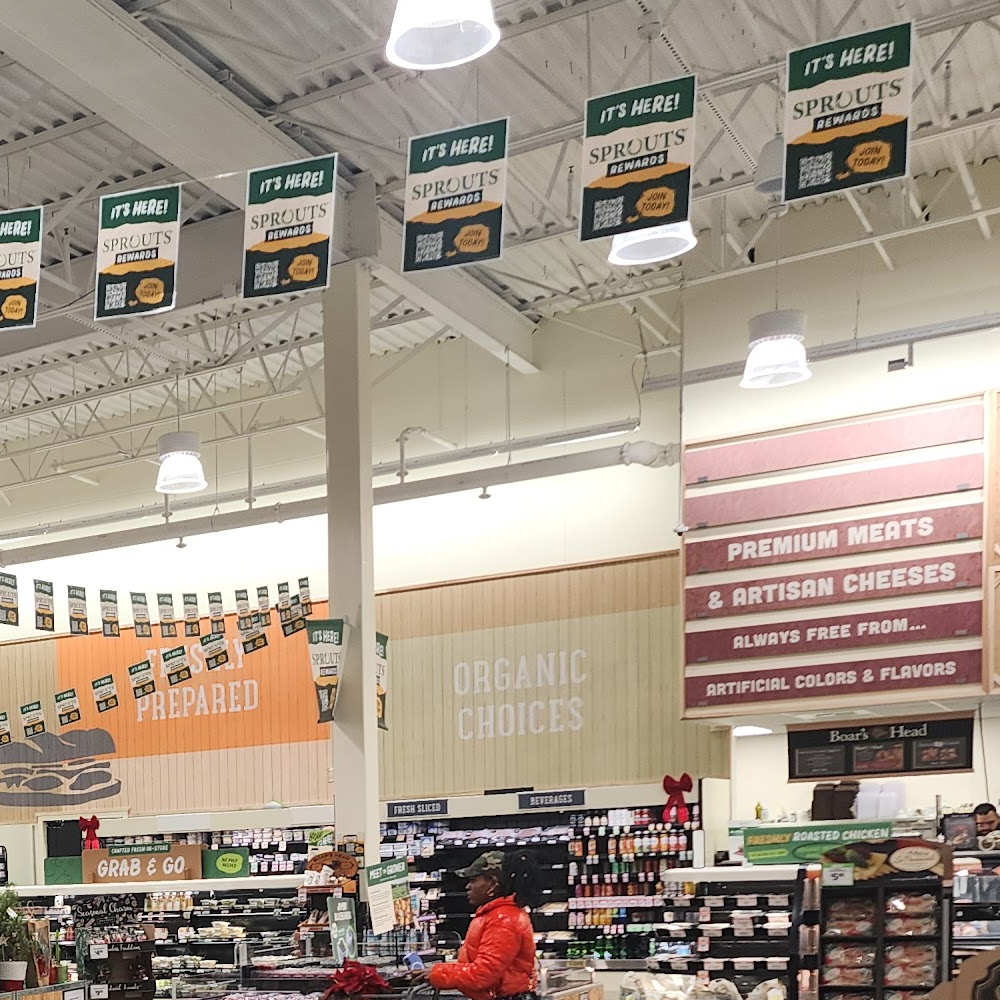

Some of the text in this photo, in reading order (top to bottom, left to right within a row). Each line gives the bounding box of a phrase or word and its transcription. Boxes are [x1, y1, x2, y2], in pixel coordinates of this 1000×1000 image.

[804, 42, 893, 76] IT'S HERE!
[600, 93, 680, 123] IT'S HERE!
[793, 79, 902, 120] SPROUTS
[816, 107, 878, 130] REWARDS
[422, 135, 494, 162] IT'S HERE!
[589, 130, 686, 165] SPROUTS
[860, 146, 880, 156] JOIN
[609, 154, 665, 175] REWARDS
[854, 155, 884, 167] TODAY!
[259, 171, 324, 194] IT'S HERE!
[412, 170, 499, 199] SPROUTS
[642, 201, 670, 211] TODAY!
[647, 193, 666, 202] JOIN
[111, 199, 168, 220] IT'S HERE!
[251, 205, 327, 230] SPROUTS
[0, 221, 32, 236] HERE!
[103, 230, 172, 252] SPROUTS
[728, 516, 934, 561] PREMIUM MEATS
[707, 562, 956, 610] & ARTISAN CHEESES
[733, 617, 927, 649] ALWAYS FREE FROM...
[453, 648, 587, 695] ORGANIC
[706, 661, 957, 697] ARTIFICIAL COLORS FLAVORS
[136, 679, 259, 722] PREPARED
[457, 696, 584, 740] CHOICES
[829, 723, 927, 742] Boar's Head
[393, 803, 441, 815] FRESH SLICED
[529, 794, 573, 806] BEVERAGES
[792, 828, 889, 842] ROASTED CHICKEN
[97, 855, 185, 877] GRAB & GO
[108, 902, 133, 913] Charm
